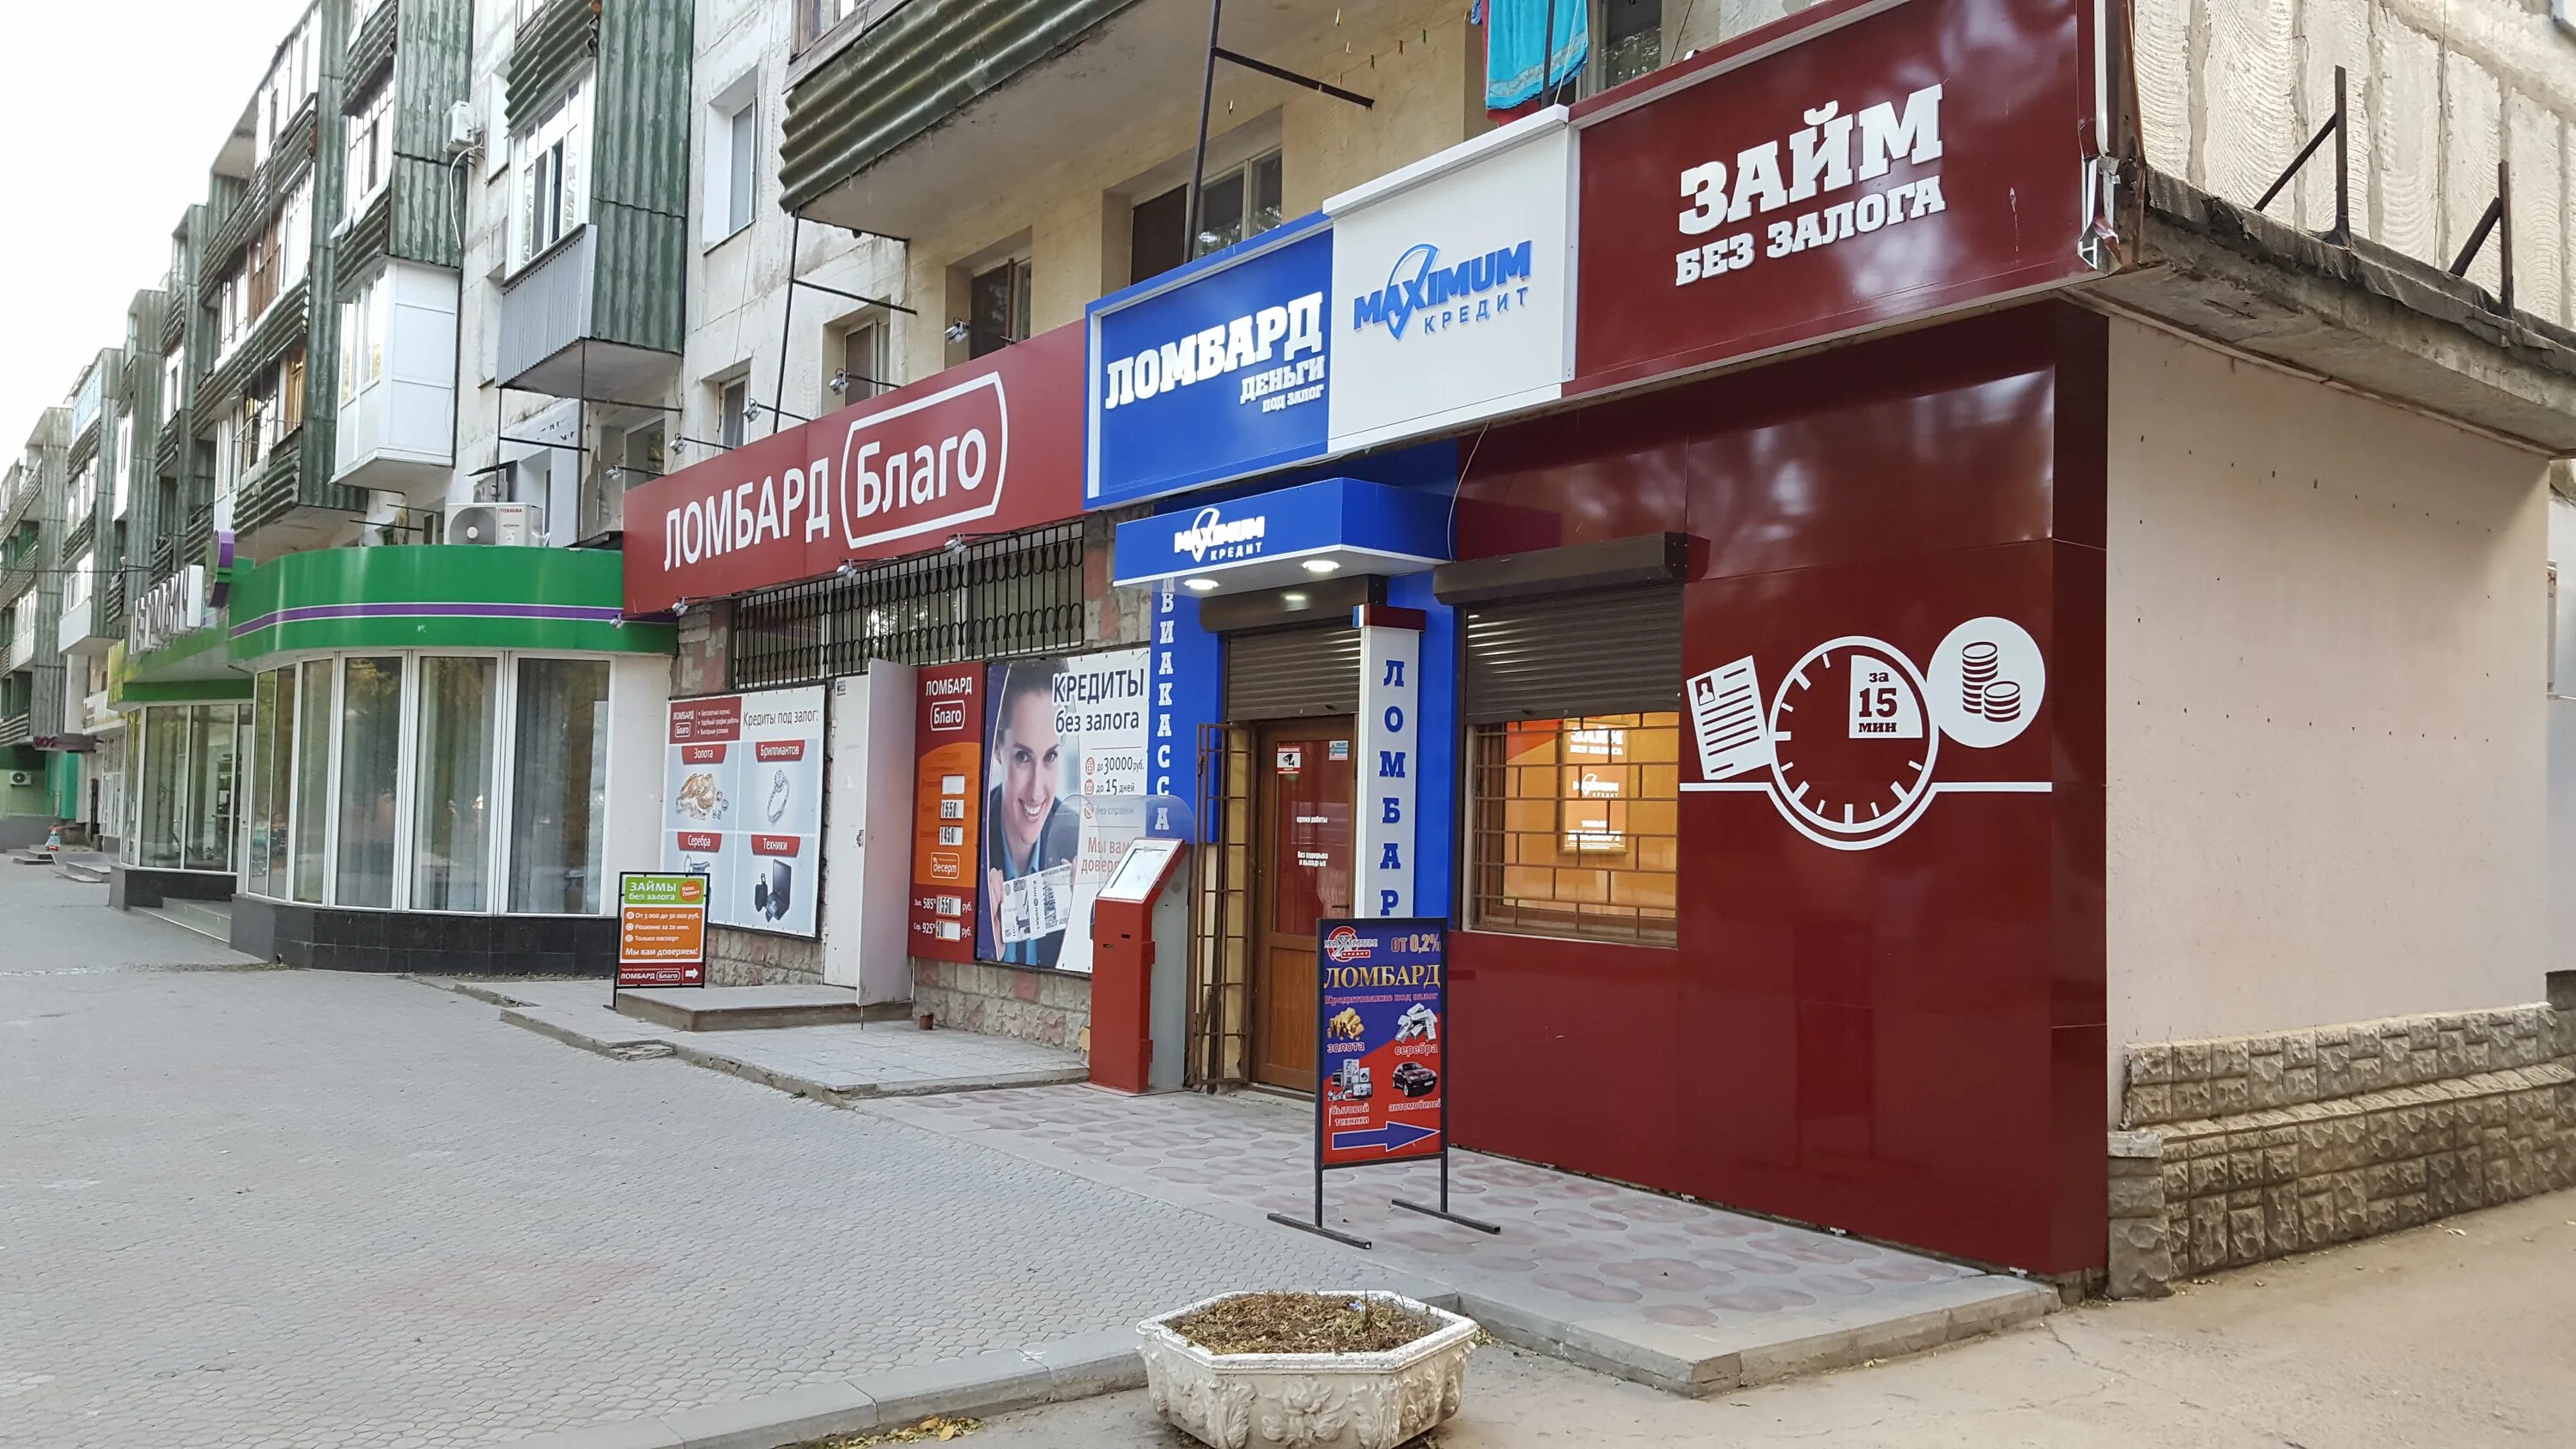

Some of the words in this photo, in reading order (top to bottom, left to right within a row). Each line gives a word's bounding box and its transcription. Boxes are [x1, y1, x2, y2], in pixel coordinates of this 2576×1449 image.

[1679, 83, 1942, 234] ЗАЙМ
[1675, 233, 1754, 286] БЕЗ
[1766, 175, 1946, 258] ЗАЛОГА
[1354, 240, 1532, 336] MAXIMUM
[1425, 286, 1529, 334] КРЕДИТ
[1105, 291, 1323, 409] ЛОМБАРД
[1240, 355, 1325, 404] ДЕНЬГИ
[1262, 393, 1285, 413] ПОД
[1287, 385, 1323, 407] ЗАЛОГ
[664, 457, 830, 572] ЛОМБАРД
[858, 428, 987, 518] Благо
[1175, 512, 1265, 558] MAXIMUM
[1211, 542, 1263, 561] КРЕДИТ
[926, 676, 972, 696] ЛОМБАРД
[1054, 669, 1145, 705] КРЕДИТЫ
[1868, 671, 1889, 683] за
[1155, 592, 1175, 830] ВИАКАССА
[1858, 688, 1897, 718] 15
[744, 712, 775, 729] Кредиты
[778, 712, 792, 724] под
[794, 709, 818, 724] залог:
[933, 708, 962, 724] Благо
[1055, 710, 1081, 733] без
[1085, 711, 1139, 731] залога
[694, 748, 713, 759] Золота
[761, 744, 799, 756] Бриллиантов
[1097, 761, 1103, 771] до
[1103, 756, 1133, 775] 30000
[1133, 760, 1145, 772] руб.
[1097, 785, 1104, 793] до
[1106, 779, 1117, 795] 15
[1119, 783, 1135, 793] дней
[1379, 660, 1406, 916] ЛОМБАР
[688, 834, 711, 849] Серебра
[763, 838, 787, 851] Техники
[1088, 836, 1106, 853] Мы
[629, 881, 676, 892] ЗАЙМЫ
[629, 892, 644, 900] без
[657, 947, 698, 957] доверяем!
[1409, 934, 1441, 954] 0,2%
[1323, 964, 1440, 989] ЛОМБАРД
[1327, 1042, 1364, 1053] золота
[1394, 1042, 1438, 1057] серебра
[1331, 1103, 1369, 1115] бытовой
[1334, 1116, 1369, 1126] техники
